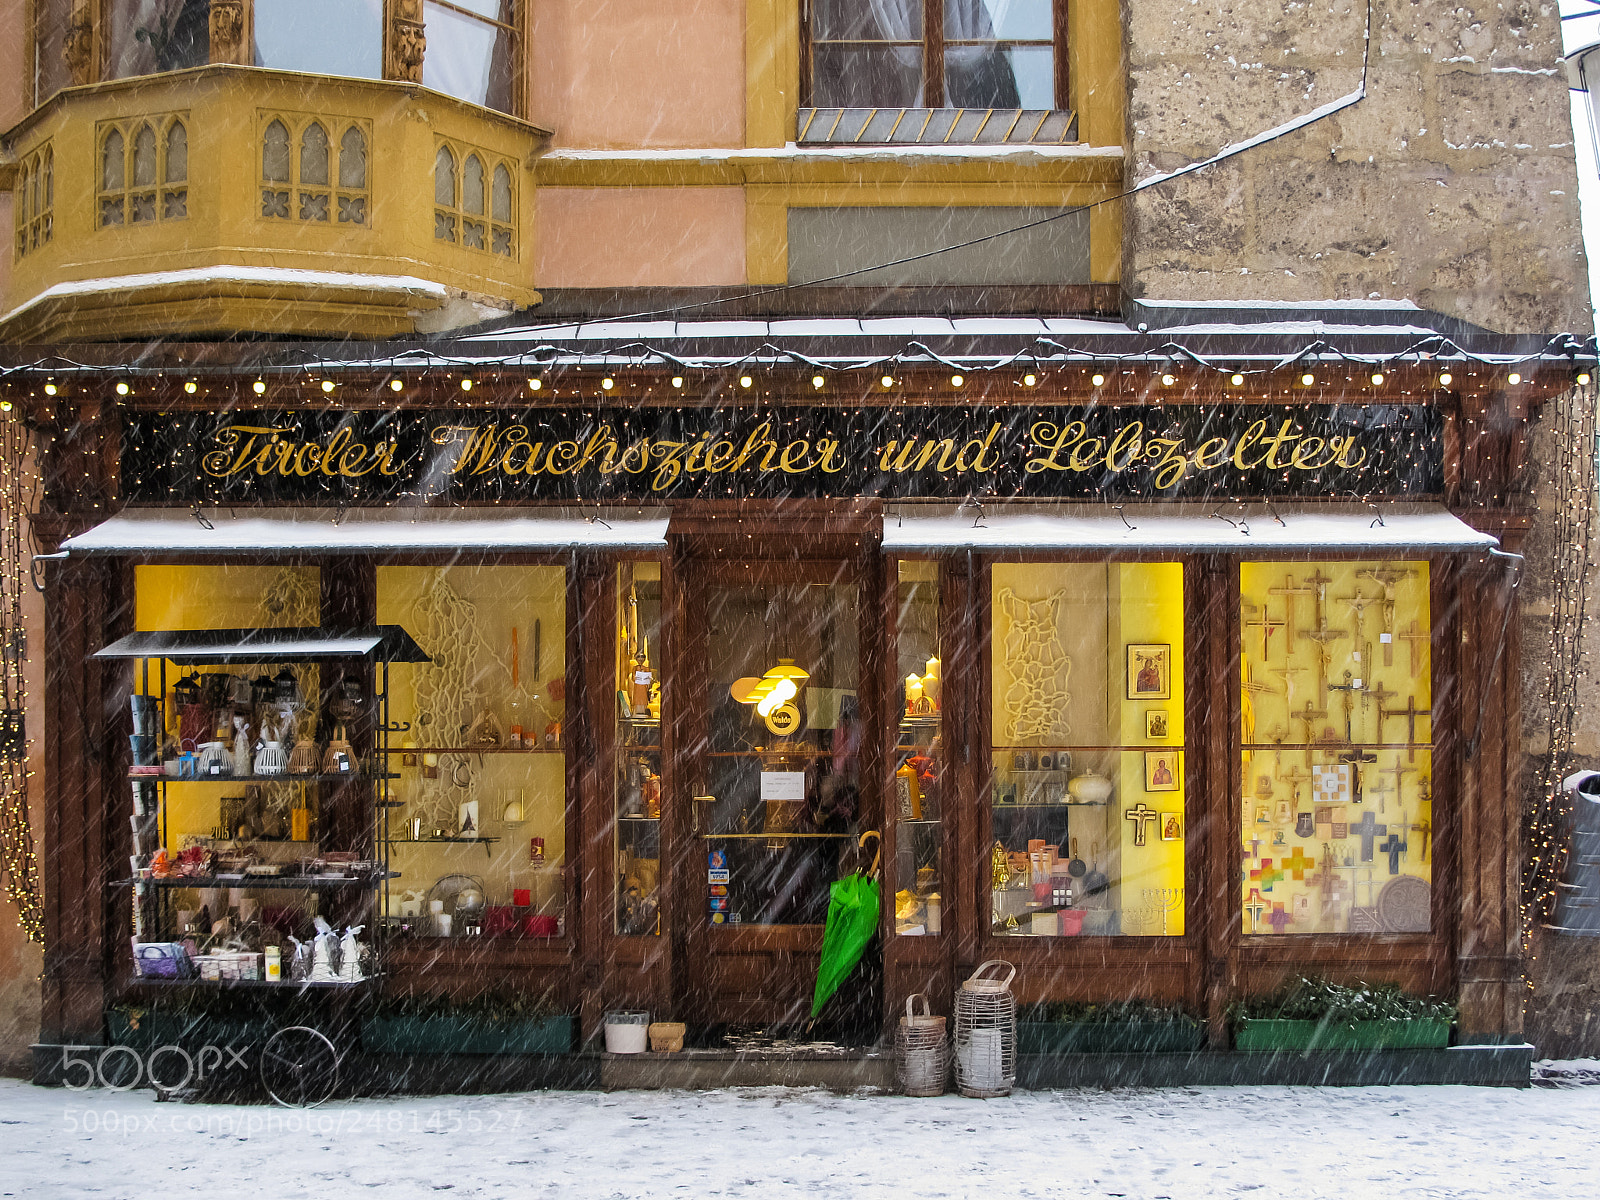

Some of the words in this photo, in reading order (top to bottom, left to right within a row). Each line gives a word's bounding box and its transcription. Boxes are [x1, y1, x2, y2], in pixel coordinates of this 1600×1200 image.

[202, 424, 404, 478] Tiroler
[430, 423, 847, 492] Wachszieher
[878, 421, 1001, 473] und
[1024, 418, 1367, 490] Lebzelter
[210, 826, 230, 840] 2015
